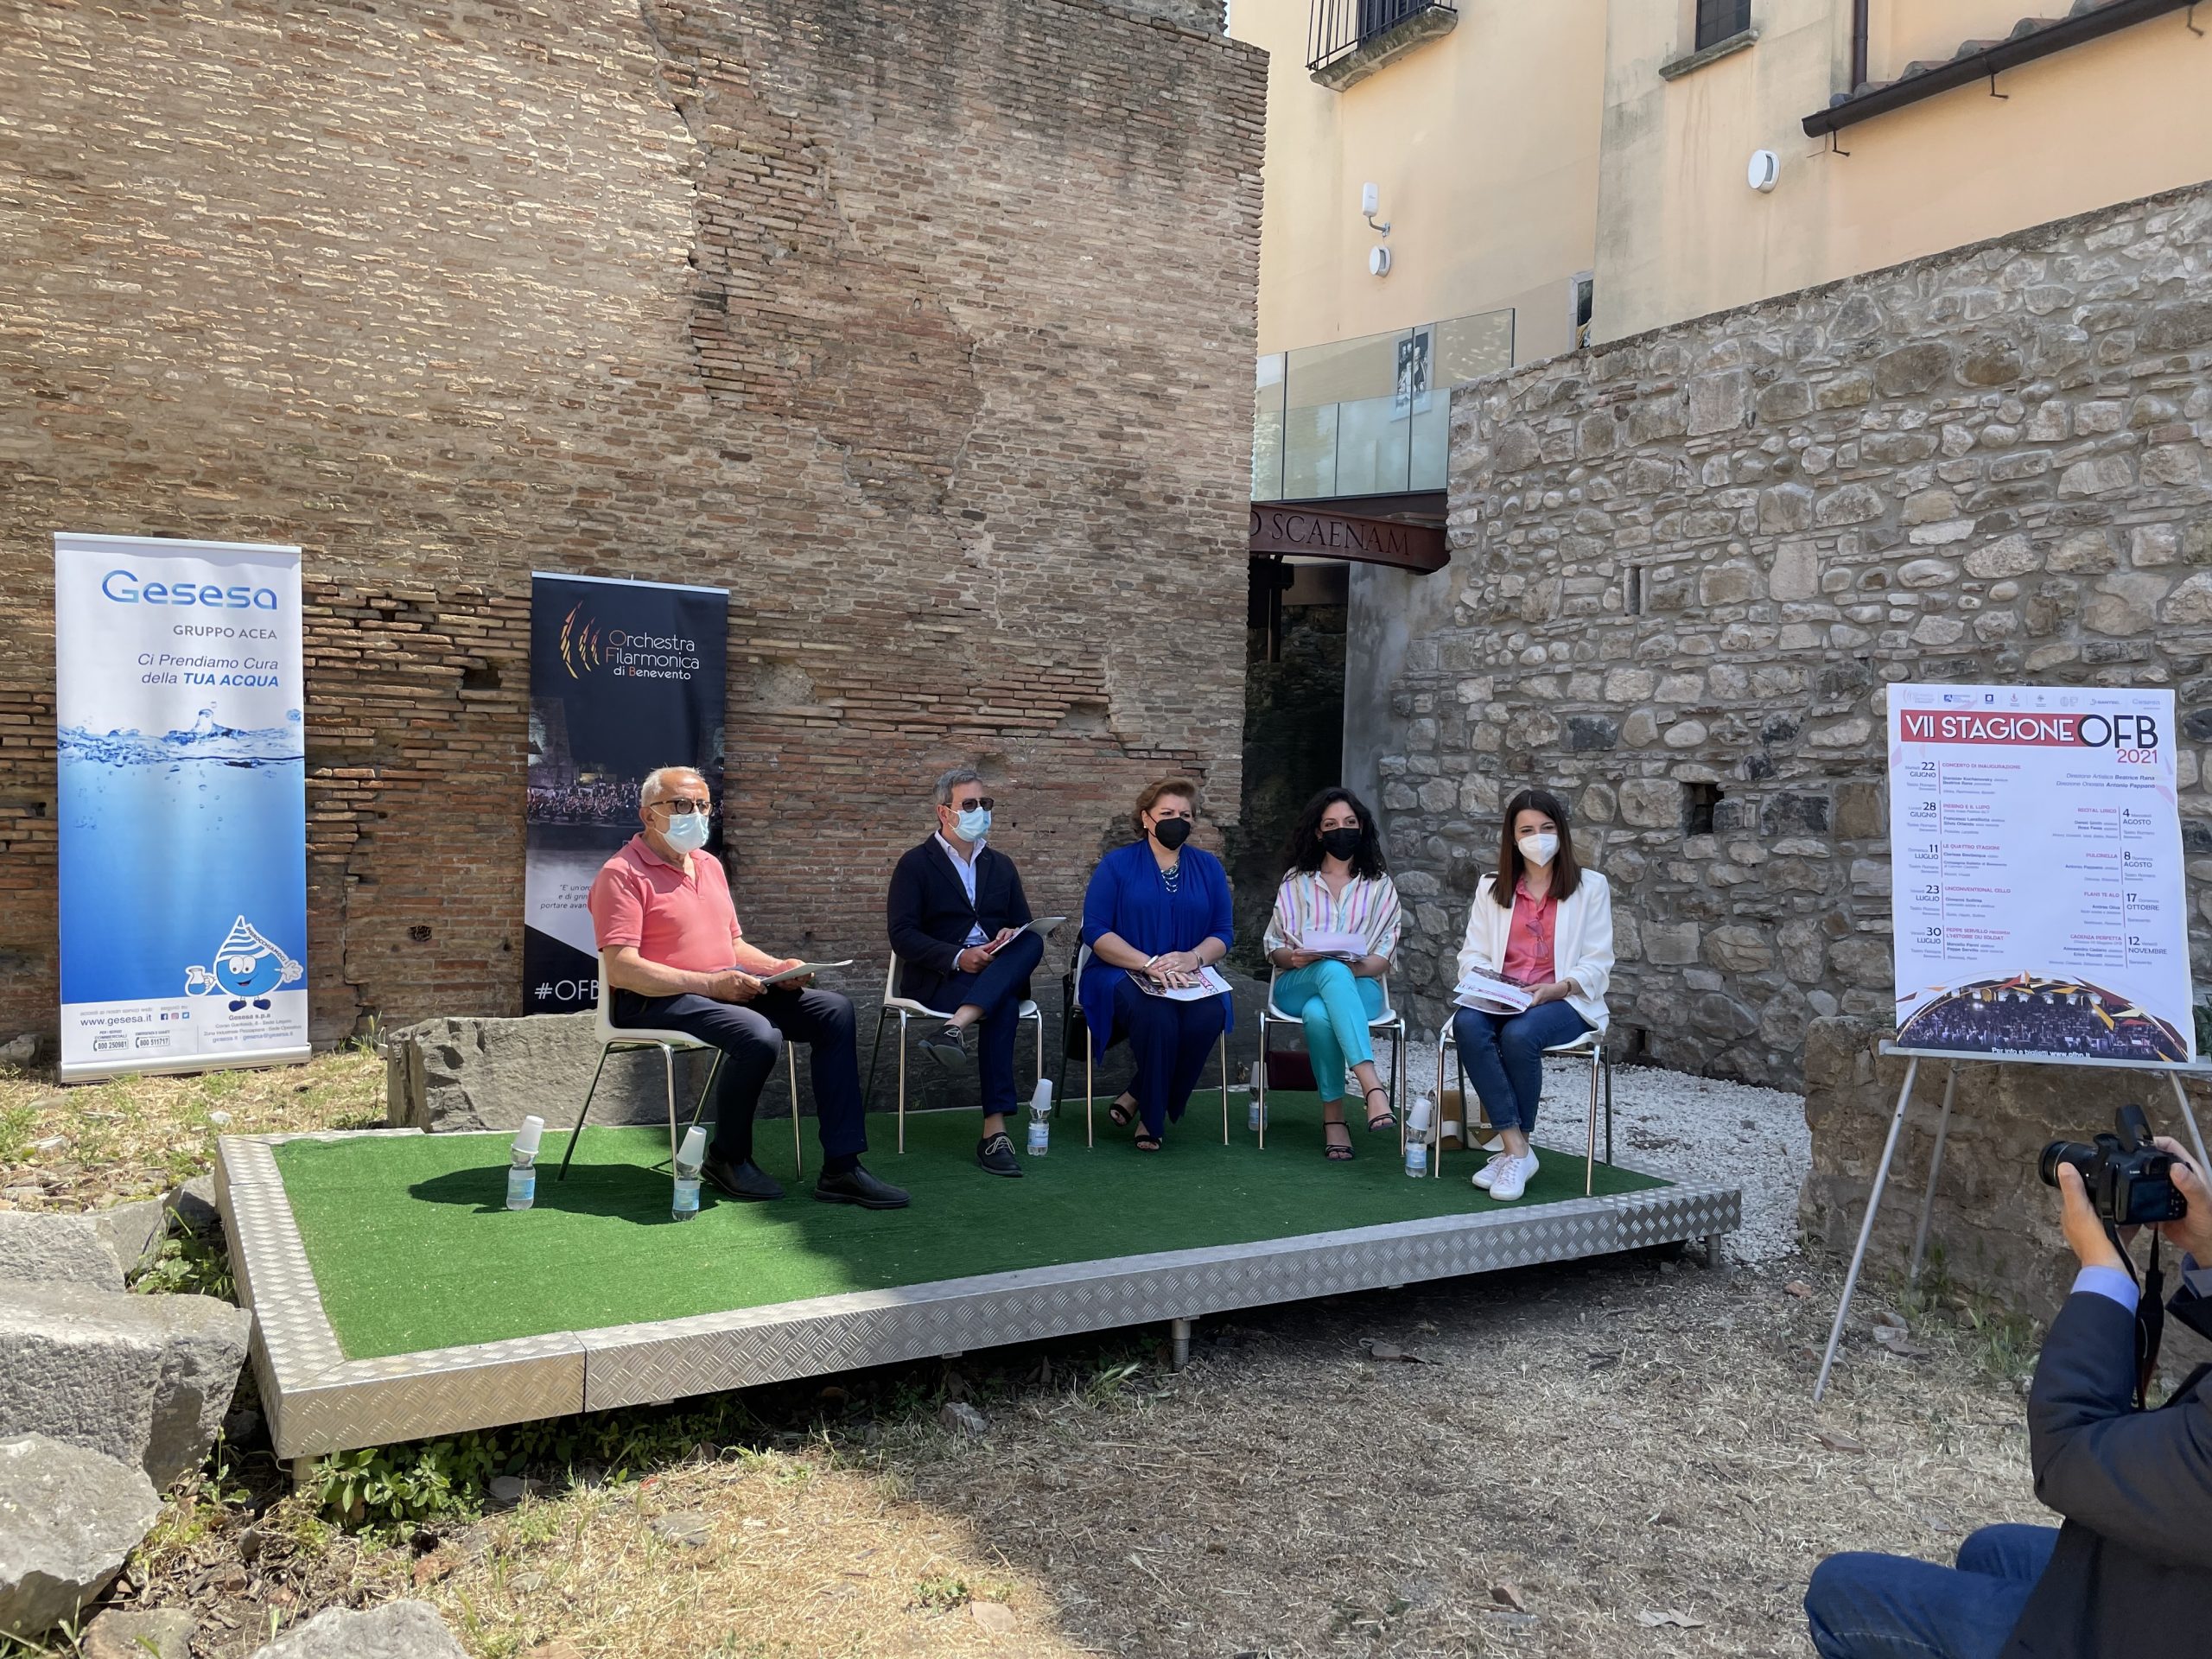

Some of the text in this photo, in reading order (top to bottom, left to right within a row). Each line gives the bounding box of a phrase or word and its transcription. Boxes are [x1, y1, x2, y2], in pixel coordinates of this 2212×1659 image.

[1272, 513, 1409, 556] SCAENAM
[102, 569, 277, 610] Gesesa
[173, 625, 277, 639] GRUPPO ACEA
[609, 629, 695, 652] Orchestra
[137, 653, 278, 670] Ci Prendiamo Cura
[606, 646, 700, 670] Filarmonica
[142, 672, 278, 687] della TUA ACQUA
[613, 666, 691, 680] di Benevento
[1905, 714, 2158, 749] VII STAGIONE OFB
[2116, 748, 2158, 764] 2021
[1921, 761, 1936, 771] 22
[1923, 802, 1936, 811] 28
[2122, 808, 2130, 817] 4
[1929, 844, 1938, 853] 11
[2124, 851, 2131, 861] 8
[1925, 885, 1940, 894] 23
[2126, 893, 2137, 902] 17
[1926, 927, 1942, 937] 30
[2128, 937, 2140, 945] 12
[535, 979, 600, 1001] #OFB
[80, 1014, 152, 1027] www.gesesa.it
